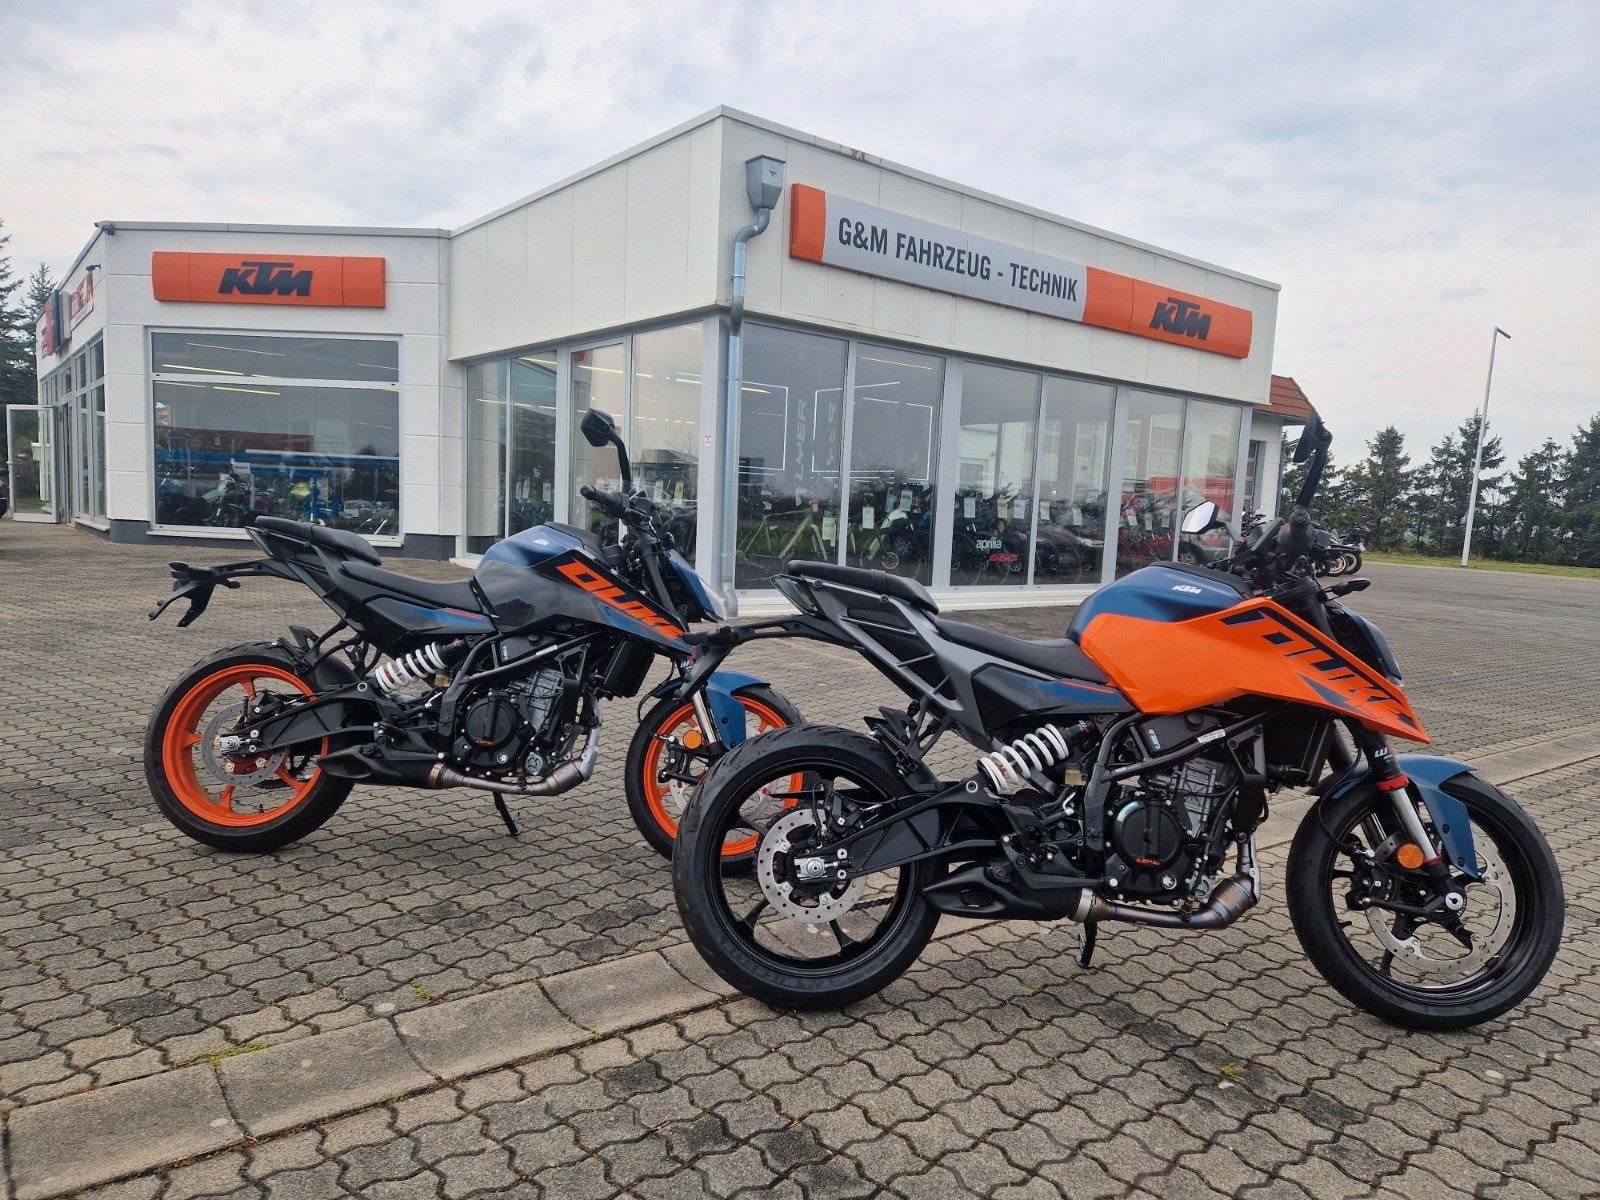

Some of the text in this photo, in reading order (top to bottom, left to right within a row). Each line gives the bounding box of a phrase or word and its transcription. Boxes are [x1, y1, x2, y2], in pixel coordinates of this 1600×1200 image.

[218, 261, 314, 297] KTM
[838, 217, 888, 255] G&M
[896, 232, 991, 281] FAHRZEUG
[1010, 262, 1078, 302] TECHNIK
[1150, 296, 1212, 340] KTM
[976, 536, 1002, 551] aprilia
[555, 557, 685, 641] DUKE
[1171, 584, 1202, 594] KTM
